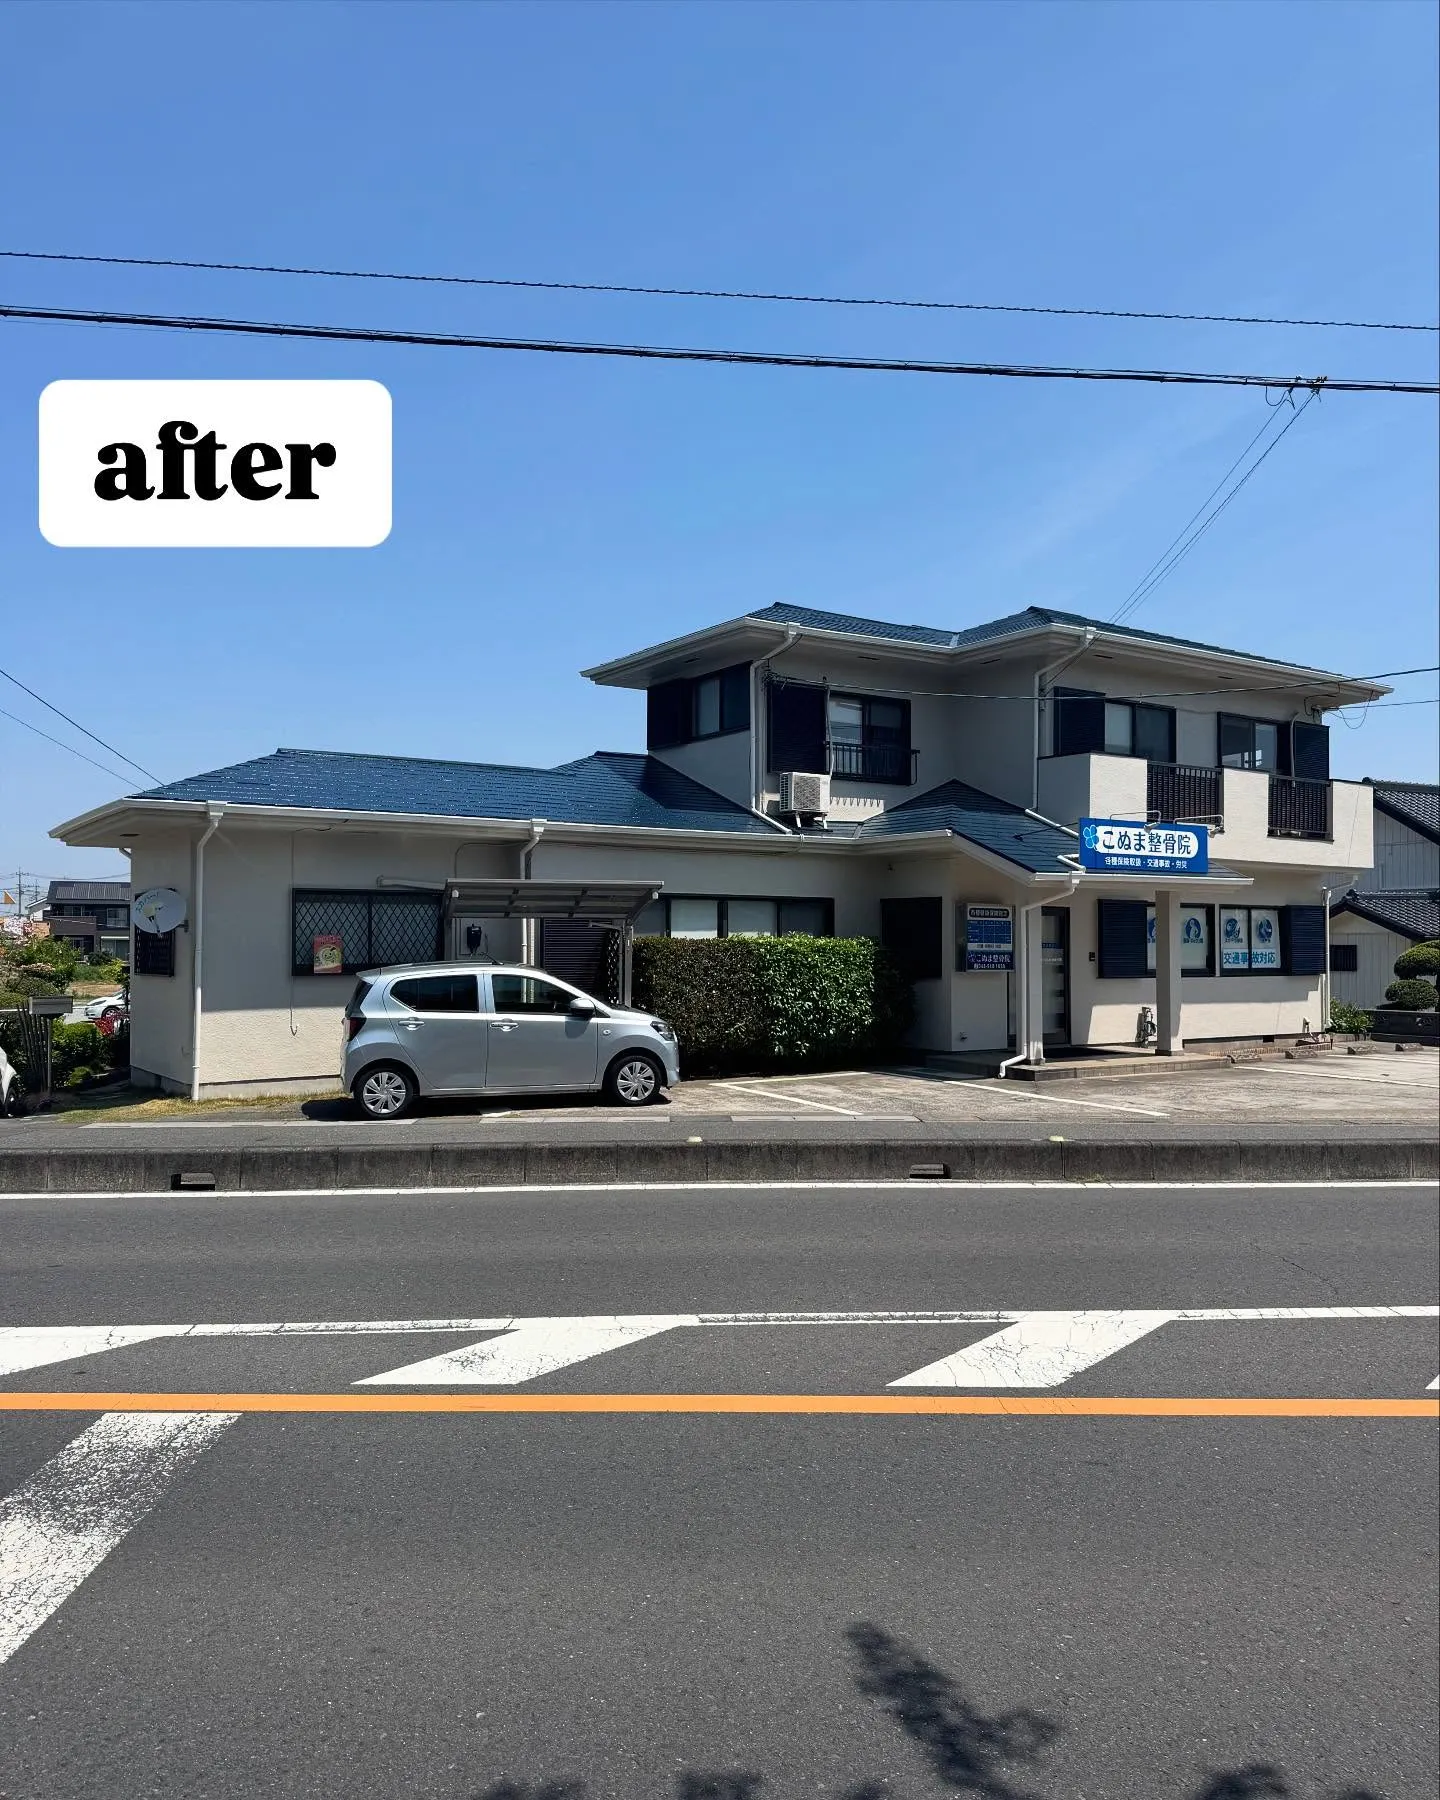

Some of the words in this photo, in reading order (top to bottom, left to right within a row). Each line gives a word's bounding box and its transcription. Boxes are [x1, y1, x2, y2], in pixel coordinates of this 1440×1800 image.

[1103, 830, 1191, 855] こぬま整骨院
[1223, 951, 1276, 965] 交通事故対応
